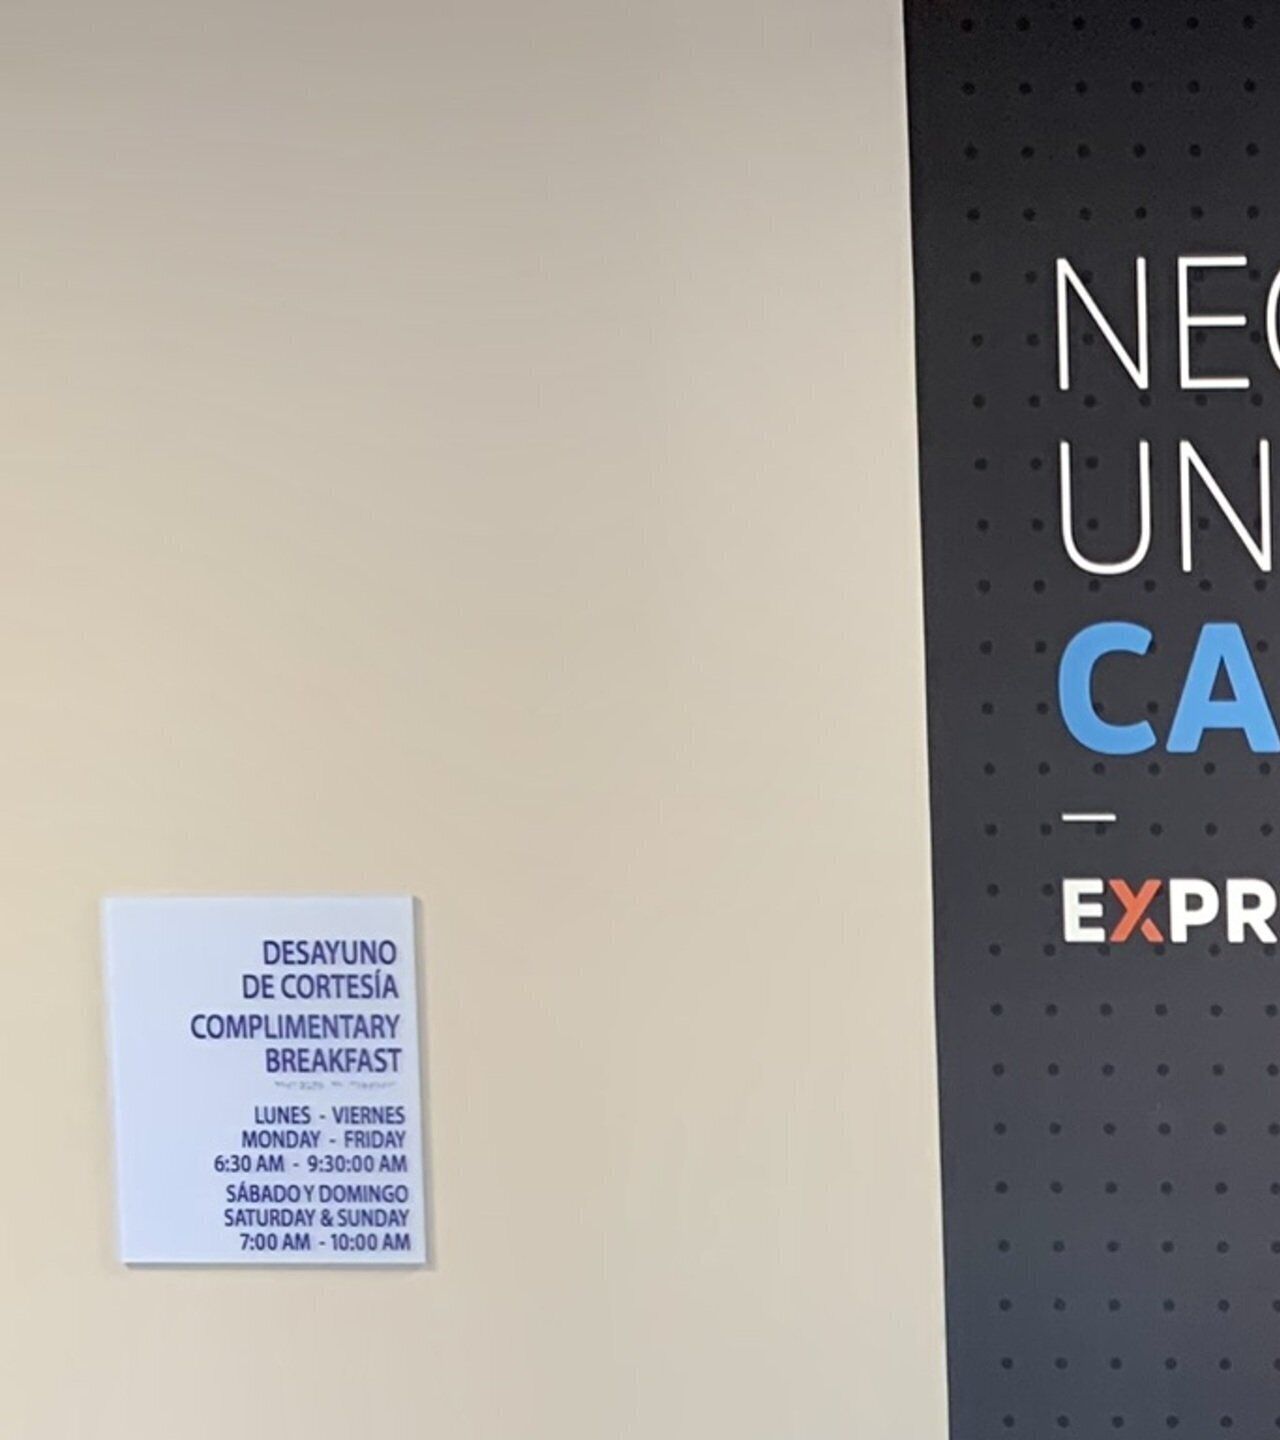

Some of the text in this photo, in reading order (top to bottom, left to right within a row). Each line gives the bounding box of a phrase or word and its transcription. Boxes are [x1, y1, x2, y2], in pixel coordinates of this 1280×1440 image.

[262, 939, 398, 966] DESAYUNO
[242, 968, 400, 1000] DE CORTESÍA
[190, 1013, 401, 1040] COMPLIMENTARY
[265, 1047, 403, 1074] BREAKFAST
[254, 1105, 312, 1126] LUNES
[331, 1105, 406, 1126] VIERNES
[241, 1129, 322, 1149] MONDAY
[343, 1129, 407, 1150] FRIDAY
[213, 1154, 252, 1173] 6:30
[255, 1154, 286, 1173] AM
[306, 1154, 375, 1174] 9:30:00
[378, 1154, 408, 1173] AM
[225, 1181, 409, 1204] SÁBADO Y DOMINGO
[223, 1207, 410, 1228] SATURDAY & SUNDAY
[239, 1232, 279, 1252] 7:00
[281, 1232, 311, 1251] AM
[330, 1232, 378, 1252] 10:00
[381, 1232, 412, 1251] AM
